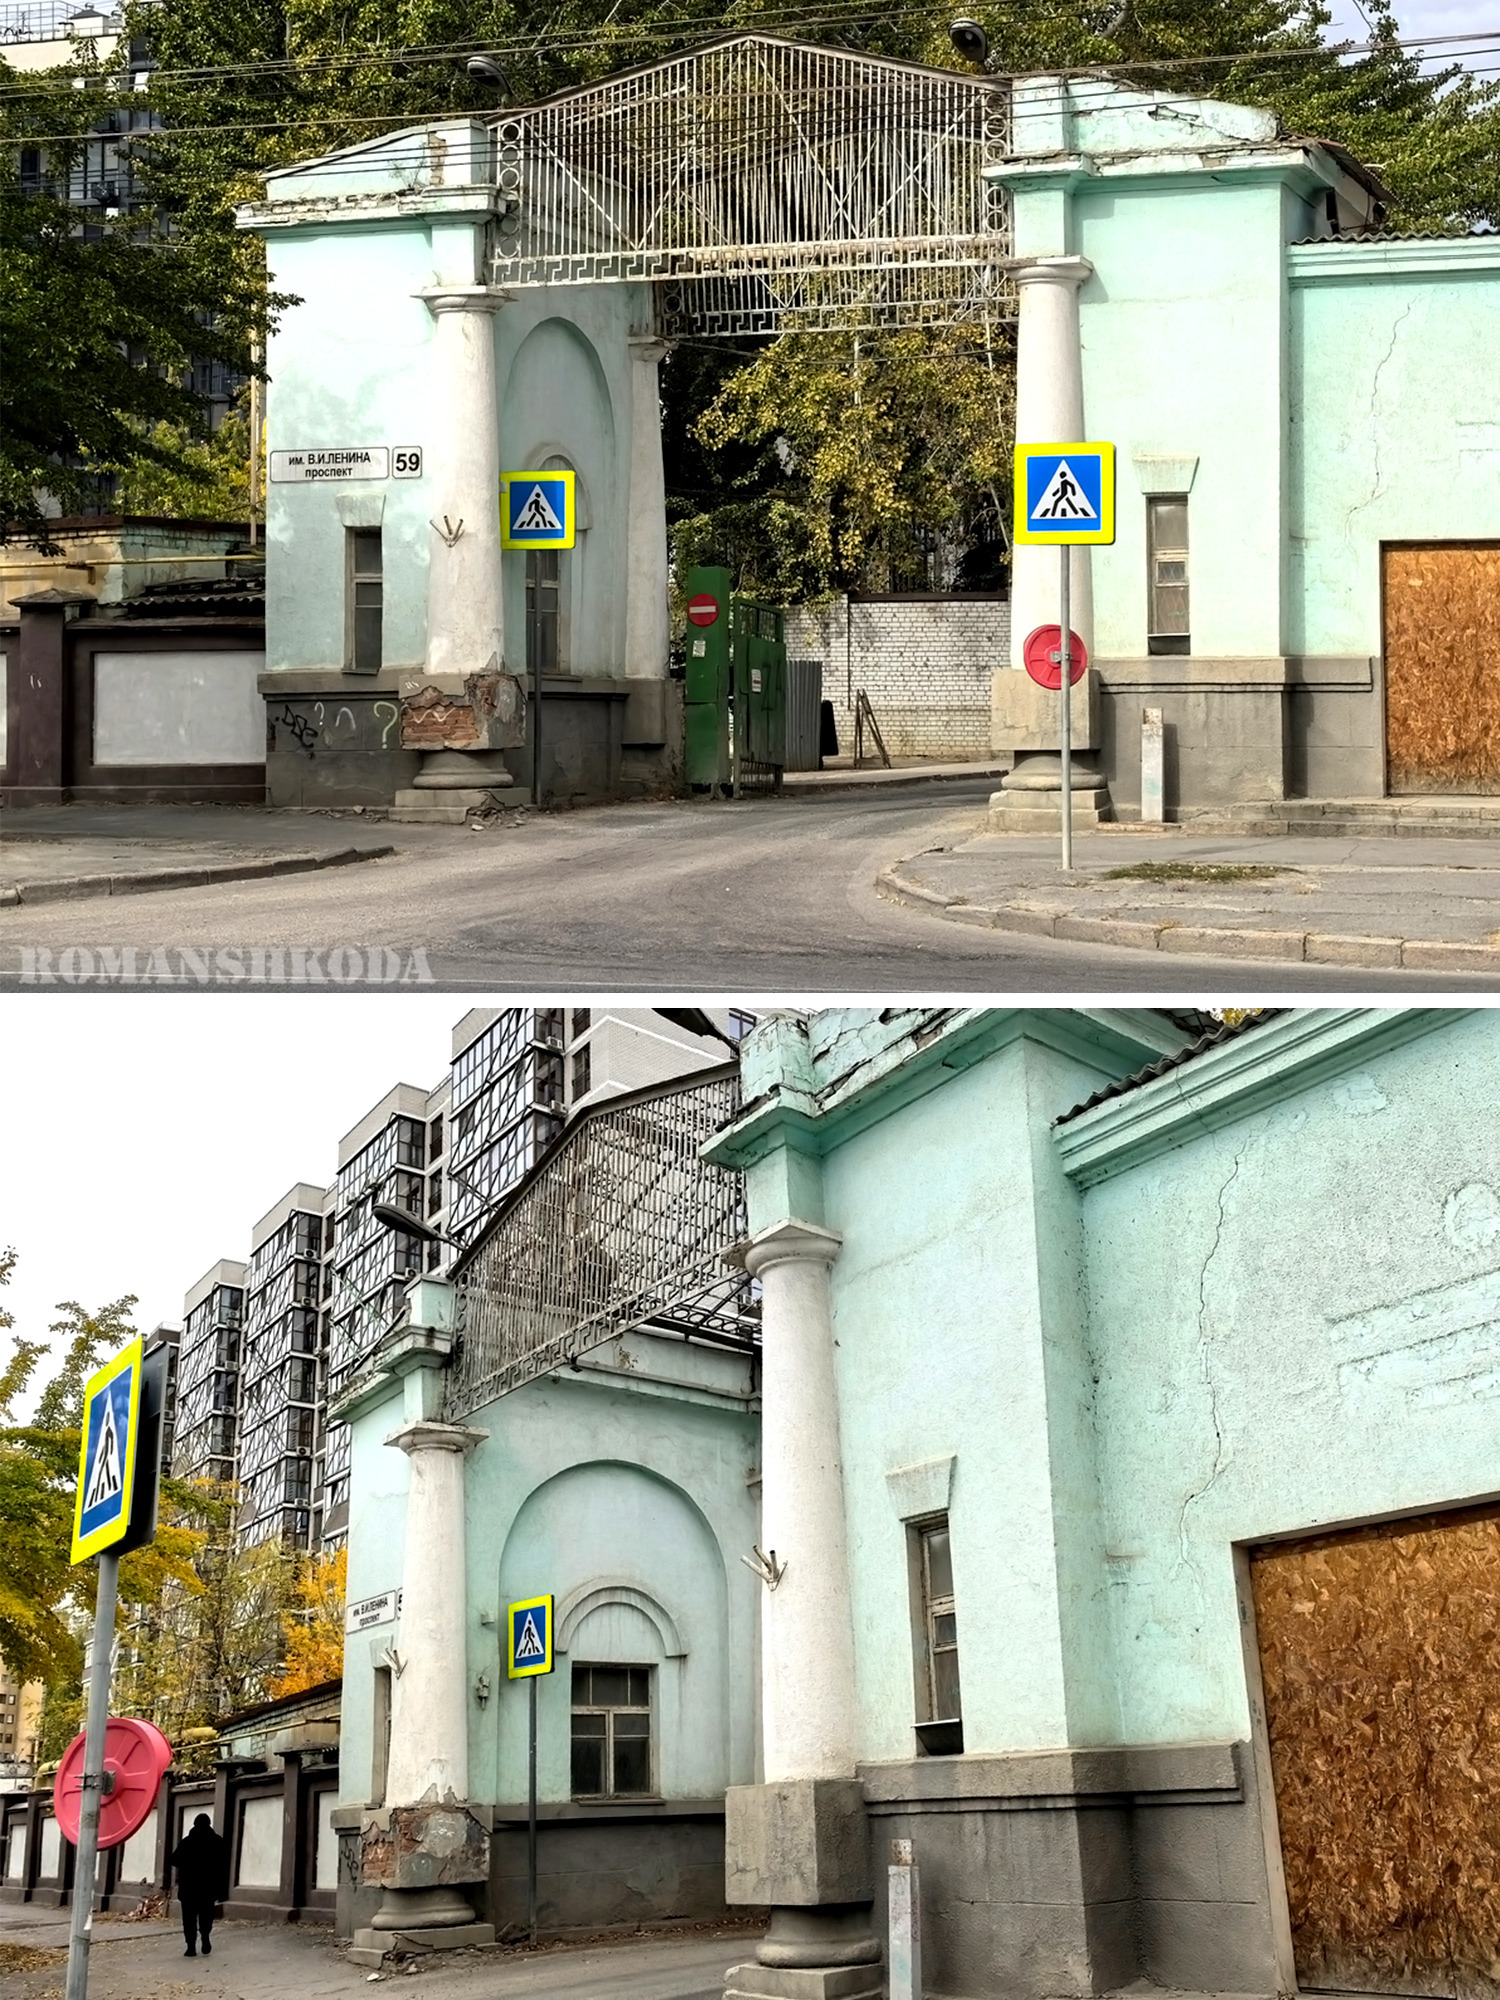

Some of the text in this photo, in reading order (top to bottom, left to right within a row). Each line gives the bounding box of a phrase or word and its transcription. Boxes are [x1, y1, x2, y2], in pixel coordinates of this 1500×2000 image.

[289, 452, 371, 465] им. В.И.ЛЕНИНА
[395, 453, 420, 471] 59
[305, 466, 353, 479] проспект
